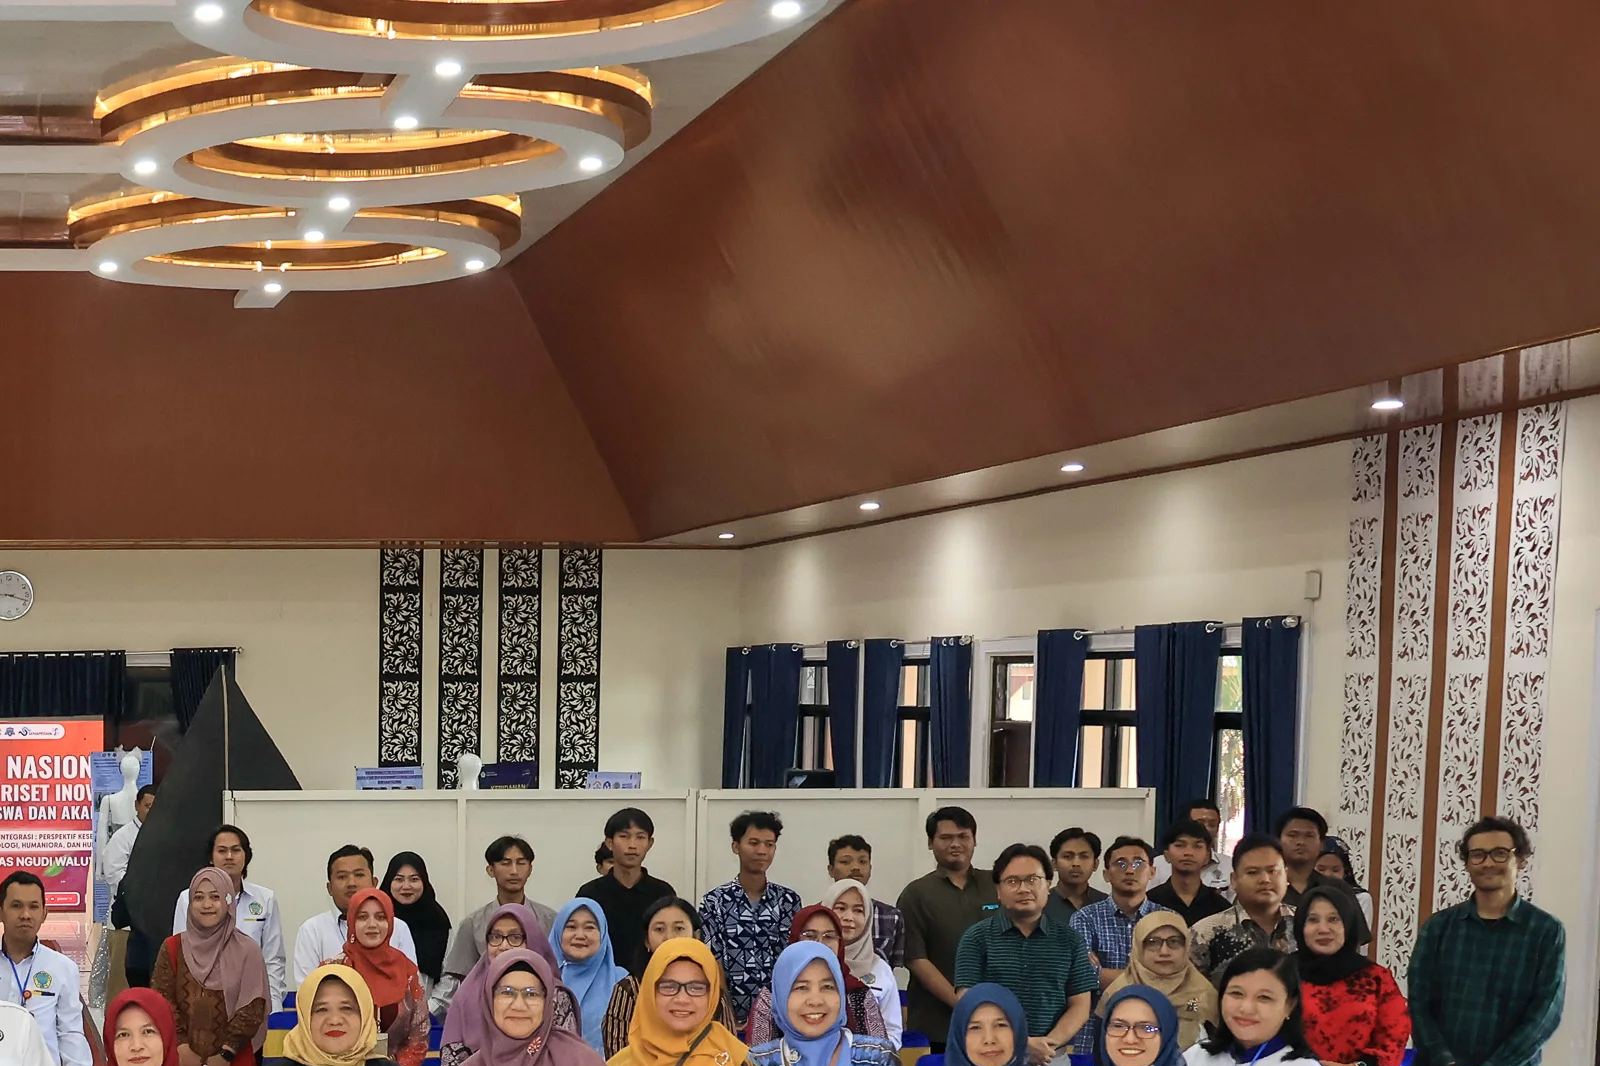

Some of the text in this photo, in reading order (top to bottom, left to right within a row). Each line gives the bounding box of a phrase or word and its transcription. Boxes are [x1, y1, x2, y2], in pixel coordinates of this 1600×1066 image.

[1, 784, 50, 802] RISET
[28, 806, 57, 821] DAN
[61, 806, 93, 821] AKA
[16, 857, 52, 867] NGUDI
